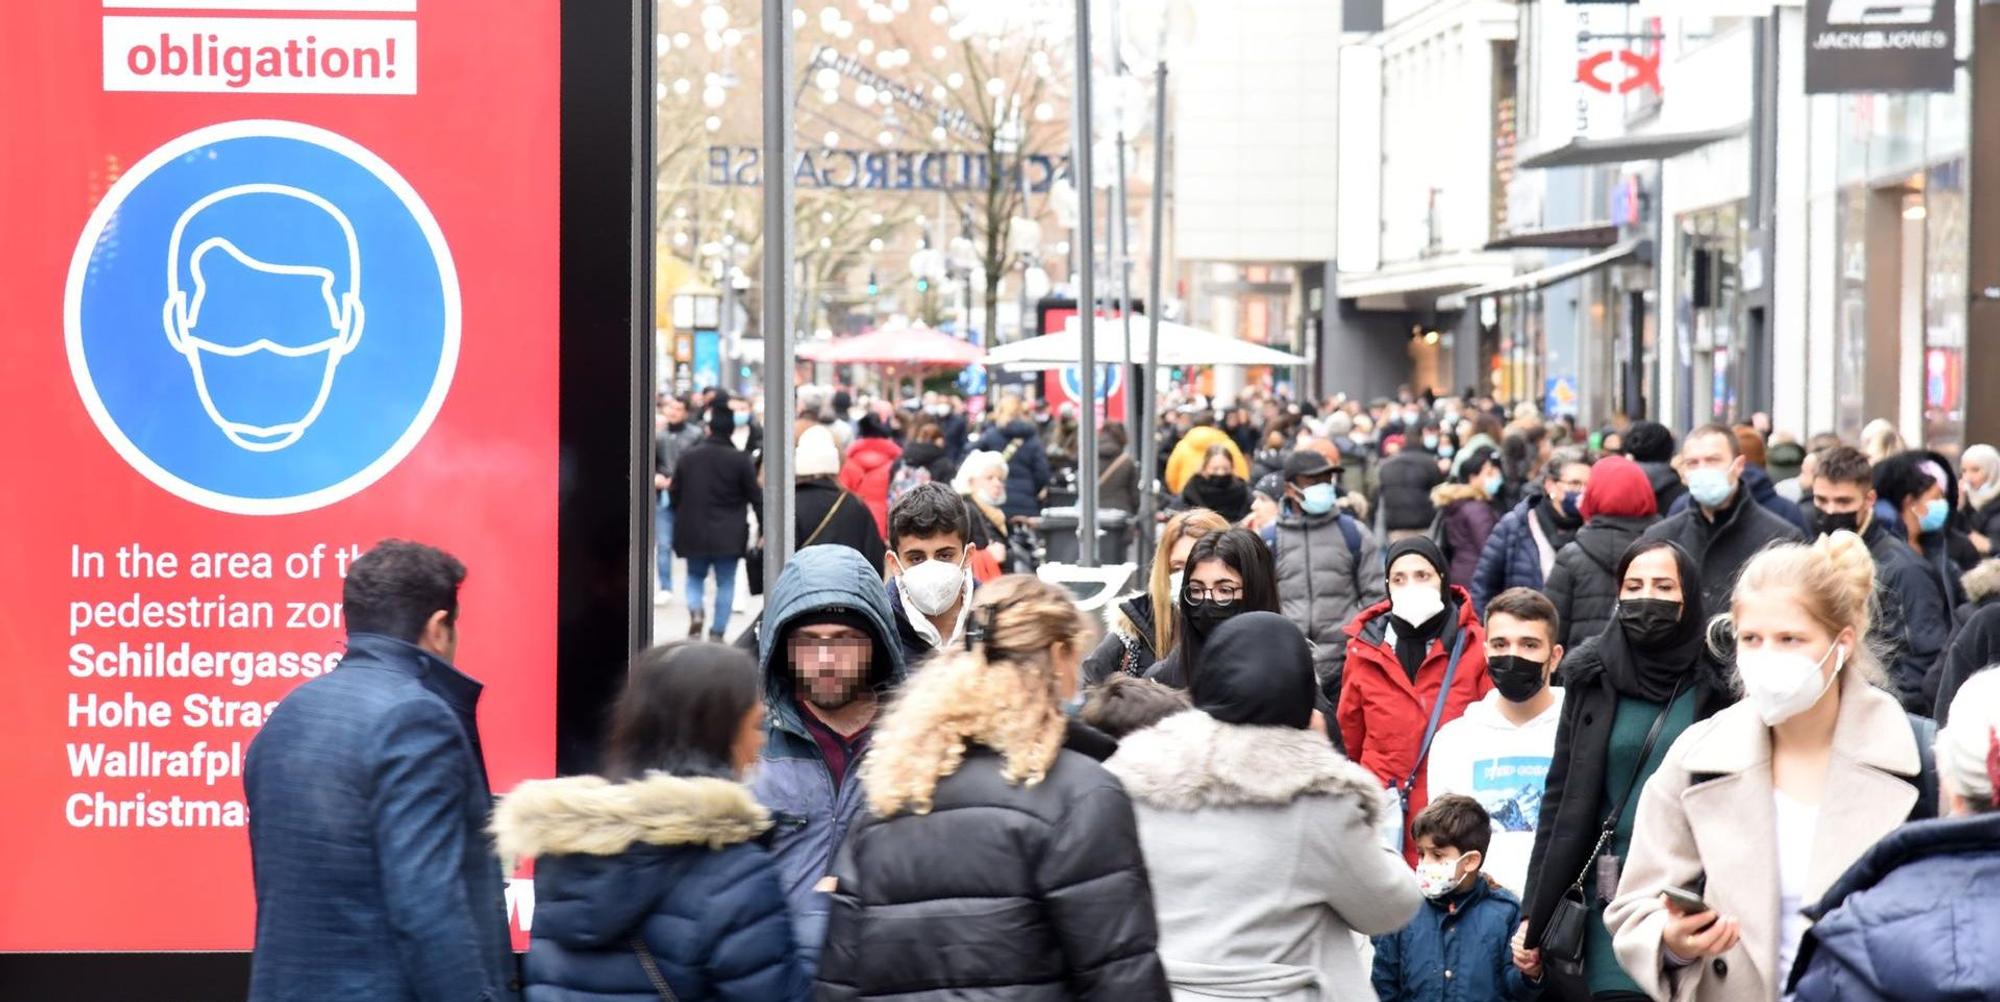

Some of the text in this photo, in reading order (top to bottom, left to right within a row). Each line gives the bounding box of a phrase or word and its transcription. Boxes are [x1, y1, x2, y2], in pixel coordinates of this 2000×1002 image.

[1884, 30, 1947, 49] JONES
[127, 33, 396, 88] obligation!
[71, 544, 105, 578] In
[116, 543, 178, 578] the
[190, 551, 273, 579] area
[285, 543, 326, 579] of
[69, 592, 273, 636] pedestrian
[68, 692, 172, 728] Hohe
[66, 741, 246, 785] Wallrafpl
